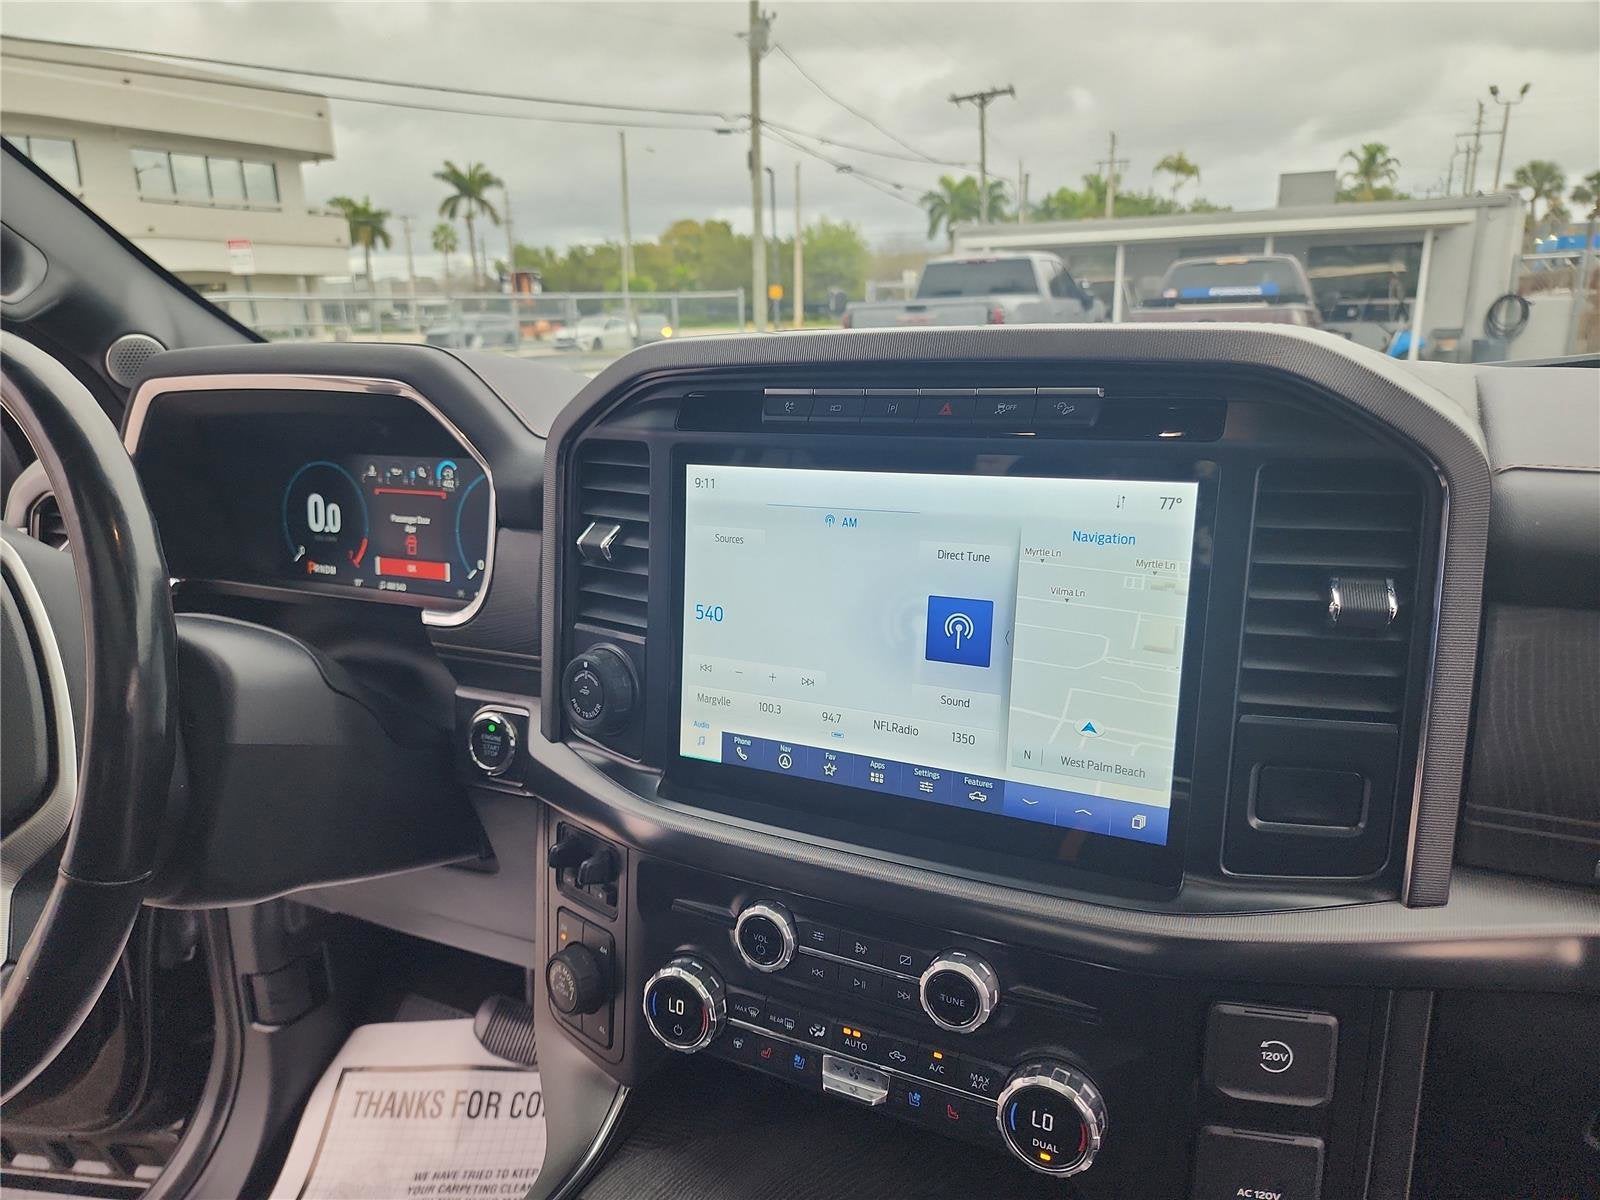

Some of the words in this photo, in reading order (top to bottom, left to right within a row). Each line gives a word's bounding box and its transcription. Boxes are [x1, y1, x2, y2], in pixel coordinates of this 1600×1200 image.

[694, 477, 716, 489] 9:11
[1159, 496, 1183, 511] 77°
[306, 492, 342, 534] 0.0
[841, 517, 858, 528] AM
[714, 533, 744, 545] Sources
[1072, 530, 1136, 547] Navigation
[937, 549, 965, 562] Direct
[967, 551, 991, 563] Tune
[1024, 547, 1049, 558] Myrtle
[1050, 548, 1062, 558] Ln
[1135, 559, 1163, 570] Myrtle
[1165, 561, 1176, 570] Ln
[1050, 586, 1073, 597] Vilma
[1075, 588, 1086, 598] Ln
[695, 604, 724, 622] 540
[940, 695, 970, 708] Sound
[571, 698, 581, 714] PRO
[582, 703, 602, 719] TRAILER
[759, 702, 782, 715] 100.3
[821, 711, 842, 724] 94.7
[693, 720, 710, 729] Audio
[873, 719, 919, 736] NFLRadio
[734, 737, 752, 746] Phone
[951, 731, 976, 746] 1350
[780, 744, 792, 753] Nav
[825, 752, 837, 761] Fav
[1023, 750, 1032, 760] N
[870, 760, 886, 770] Apps
[1060, 756, 1085, 769] West
[1087, 760, 1113, 773] Palm
[1115, 765, 1146, 779] Beach
[914, 767, 941, 780] Settings
[964, 777, 994, 789] Features
[753, 933, 769, 944] VOL
[940, 993, 966, 1008] TUNE
[734, 1003, 749, 1013] MAX
[769, 1014, 784, 1025] REAR
[844, 1038, 868, 1051] AUTO
[1261, 1051, 1289, 1062] 120V
[928, 1063, 945, 1074] A/C
[969, 1072, 990, 1085] MAX
[971, 1081, 988, 1092] A/C
[353, 1089, 445, 1119] THANKS
[451, 1089, 502, 1120] FOR
[509, 1091, 545, 1119] CO
[1032, 1138, 1060, 1154] DUAL
[414, 1172, 429, 1181] WE
[432, 1170, 458, 1181] HAVE
[462, 1169, 493, 1180] TRIED
[496, 1169, 509, 1179] TO
[512, 1168, 540, 1179] KEEP
[408, 1185, 436, 1195] YOUR
[438, 1183, 498, 1194] CARPETING
[1236, 1188, 1252, 1198] AC
[1254, 1190, 1281, 1200] 120V
